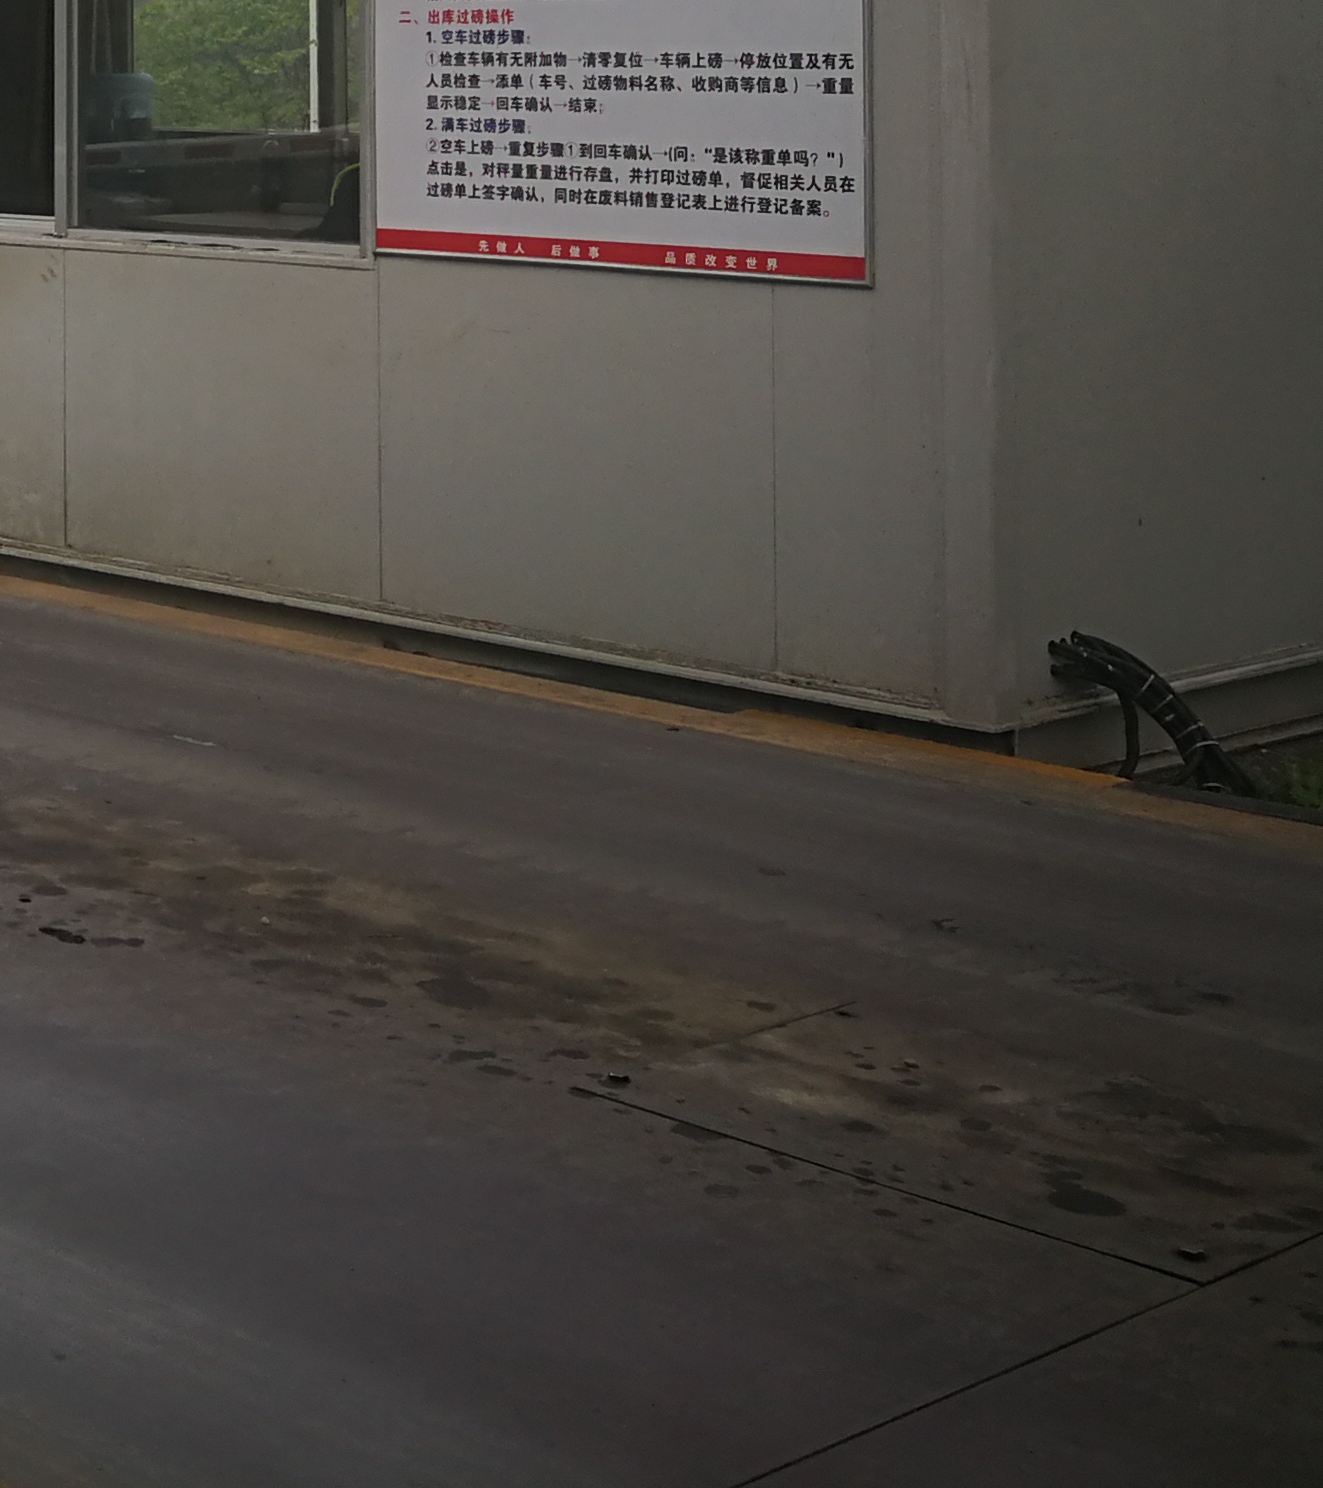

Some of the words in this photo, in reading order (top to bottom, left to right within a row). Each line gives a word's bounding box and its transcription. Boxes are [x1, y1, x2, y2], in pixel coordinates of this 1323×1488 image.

[477, 239, 526, 255] 先做人
[550, 243, 601, 260] 后做事
[664, 250, 779, 272] 品质改变世界
